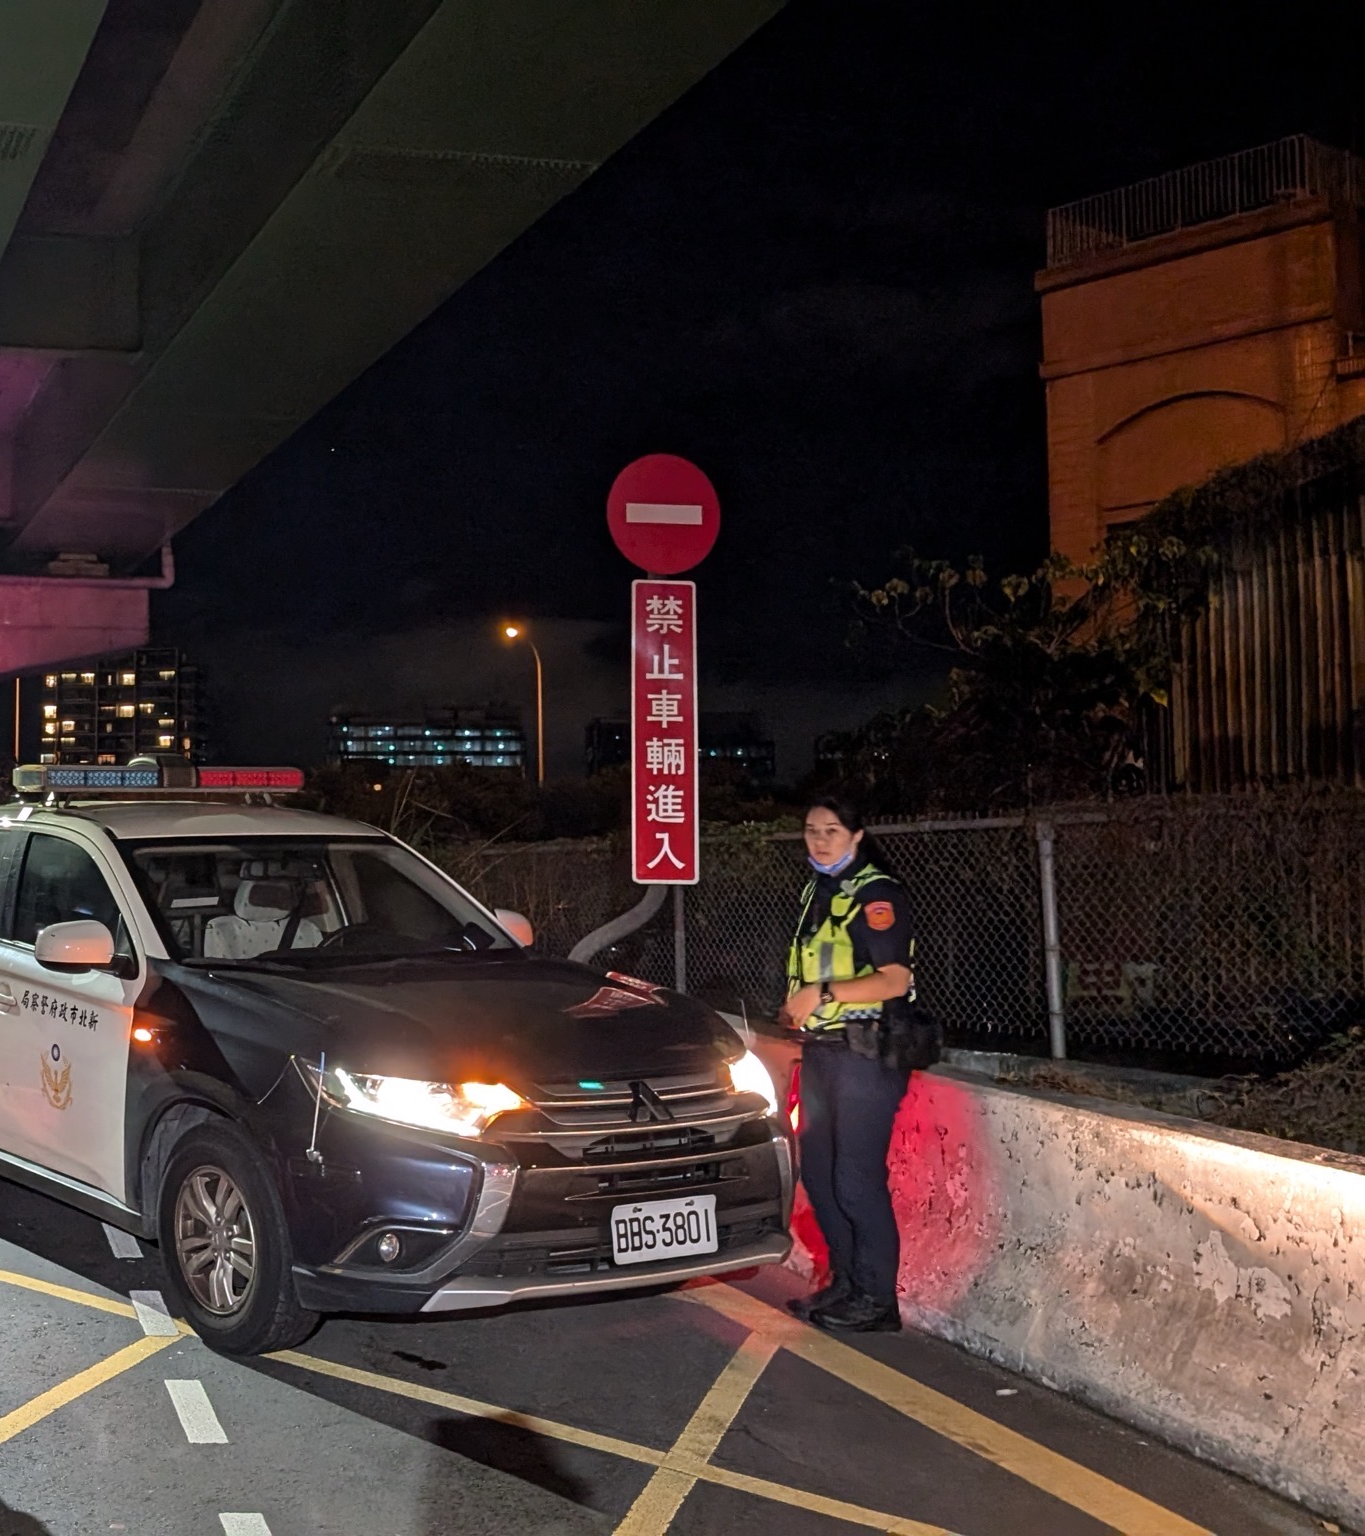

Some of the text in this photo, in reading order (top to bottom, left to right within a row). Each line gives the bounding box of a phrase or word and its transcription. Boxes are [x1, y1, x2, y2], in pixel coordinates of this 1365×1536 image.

[645, 595, 685, 869] 禁止車輛進入
